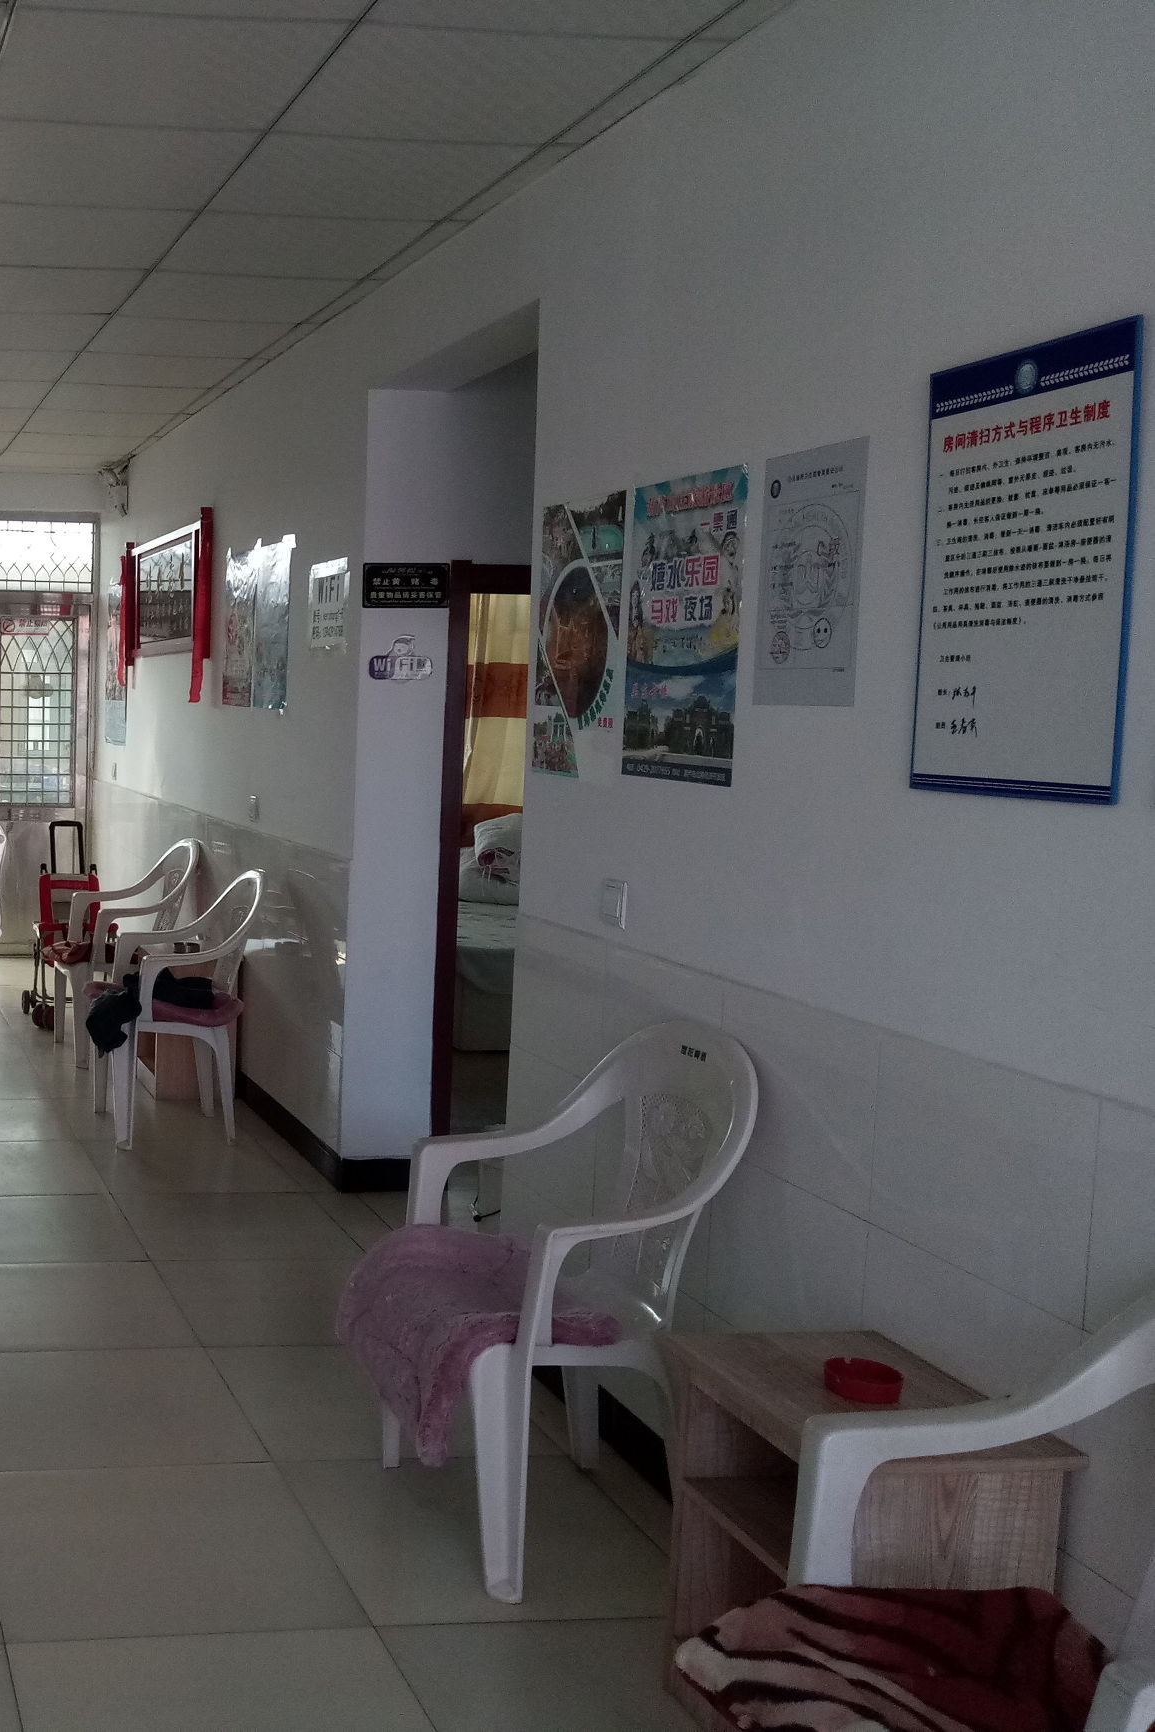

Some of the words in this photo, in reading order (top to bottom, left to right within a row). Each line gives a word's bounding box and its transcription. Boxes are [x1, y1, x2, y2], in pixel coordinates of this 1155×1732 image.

[942, 400, 1111, 453] 房间清扫方式与程序卫生制度
[700, 509, 738, 530] 一票通
[651, 555, 719, 591] 嬉水乐园
[651, 597, 679, 624] 马戏
[684, 595, 713, 621] 夜场
